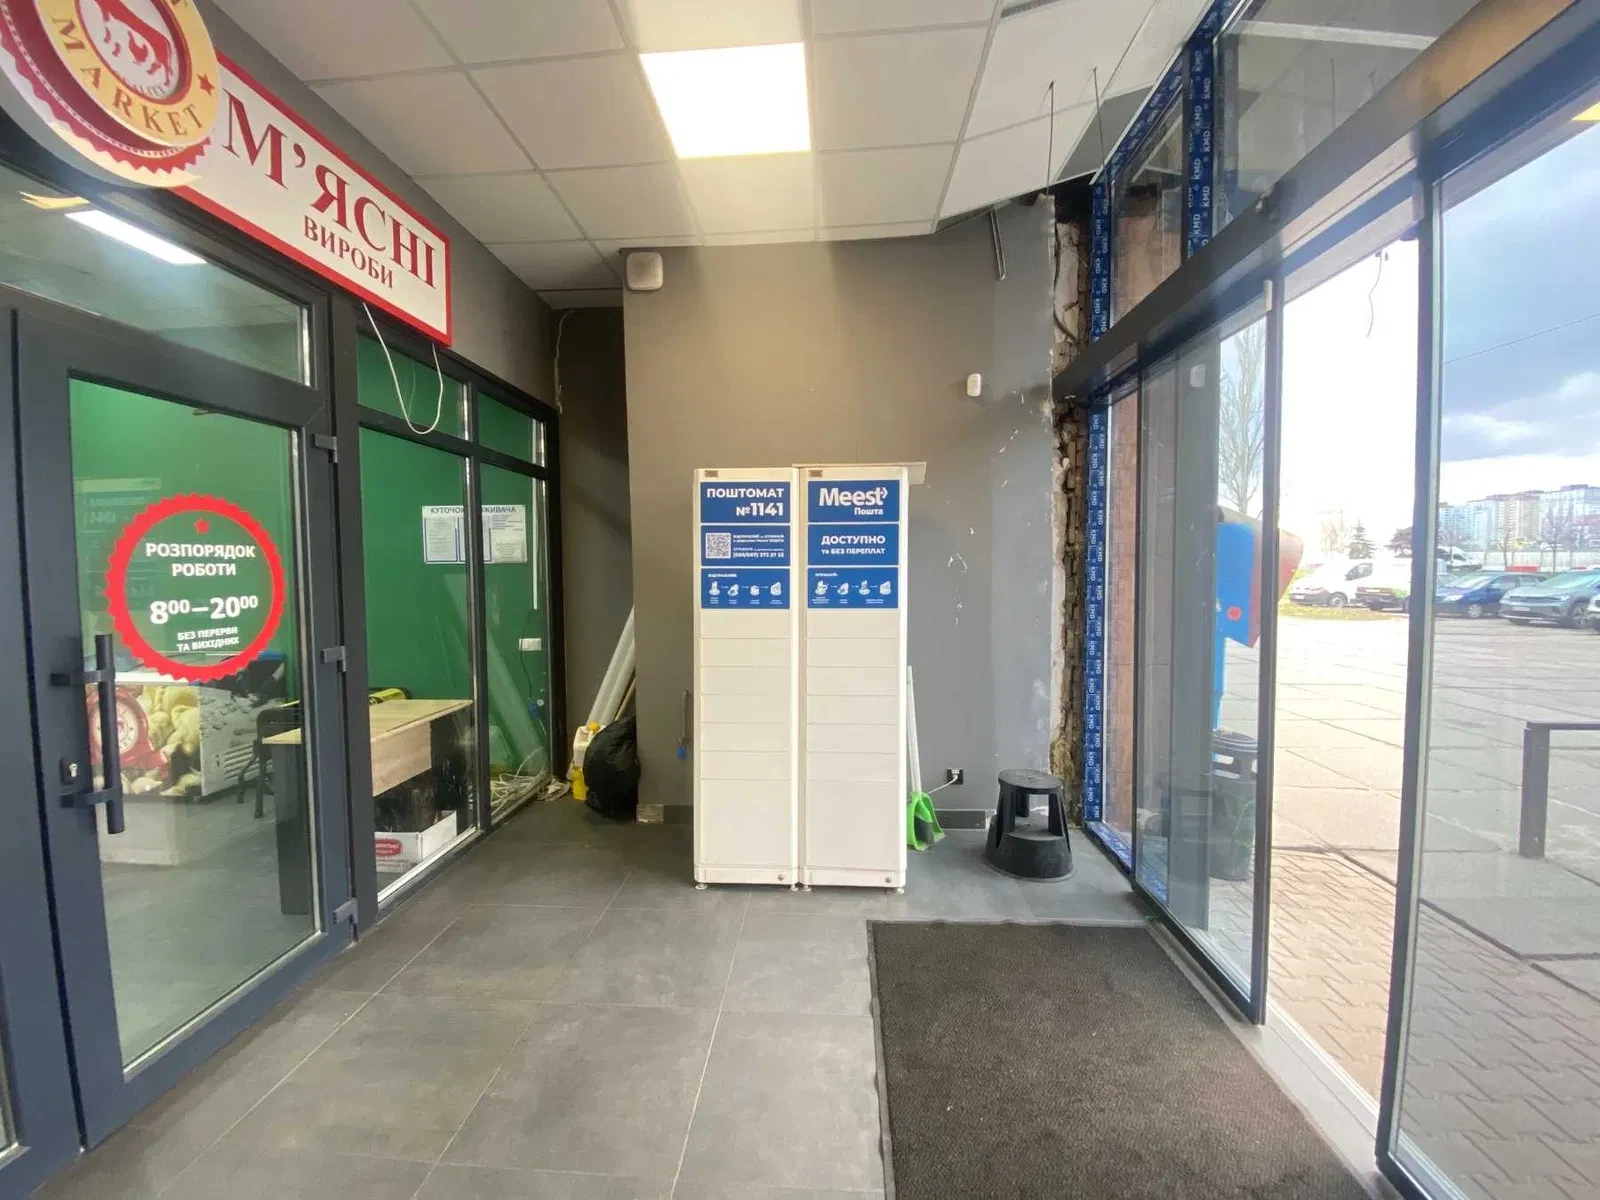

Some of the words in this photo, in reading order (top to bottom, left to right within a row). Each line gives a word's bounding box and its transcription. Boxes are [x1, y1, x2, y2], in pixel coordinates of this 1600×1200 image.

[49, 15, 203, 137] MARKET
[302, 213, 395, 290] ВИРОБИ
[706, 488, 784, 498] ПОШТОМАТ
[819, 487, 887, 507] Meest
[735, 502, 784, 516] №1141
[854, 507, 884, 515] Пошта
[821, 535, 886, 545] ДОСТУПНО
[145, 543, 256, 560] РОЗПОРЯДОК
[846, 547, 886, 555] ПЕРЕПЛАТ
[172, 562, 237, 577] РОБОТИ
[177, 630, 196, 641] БЕЗ
[197, 626, 239, 639] ПЕРЕРВИ
[177, 642, 190, 653] ТА
[192, 636, 240, 650] ВИХІДНИХ
